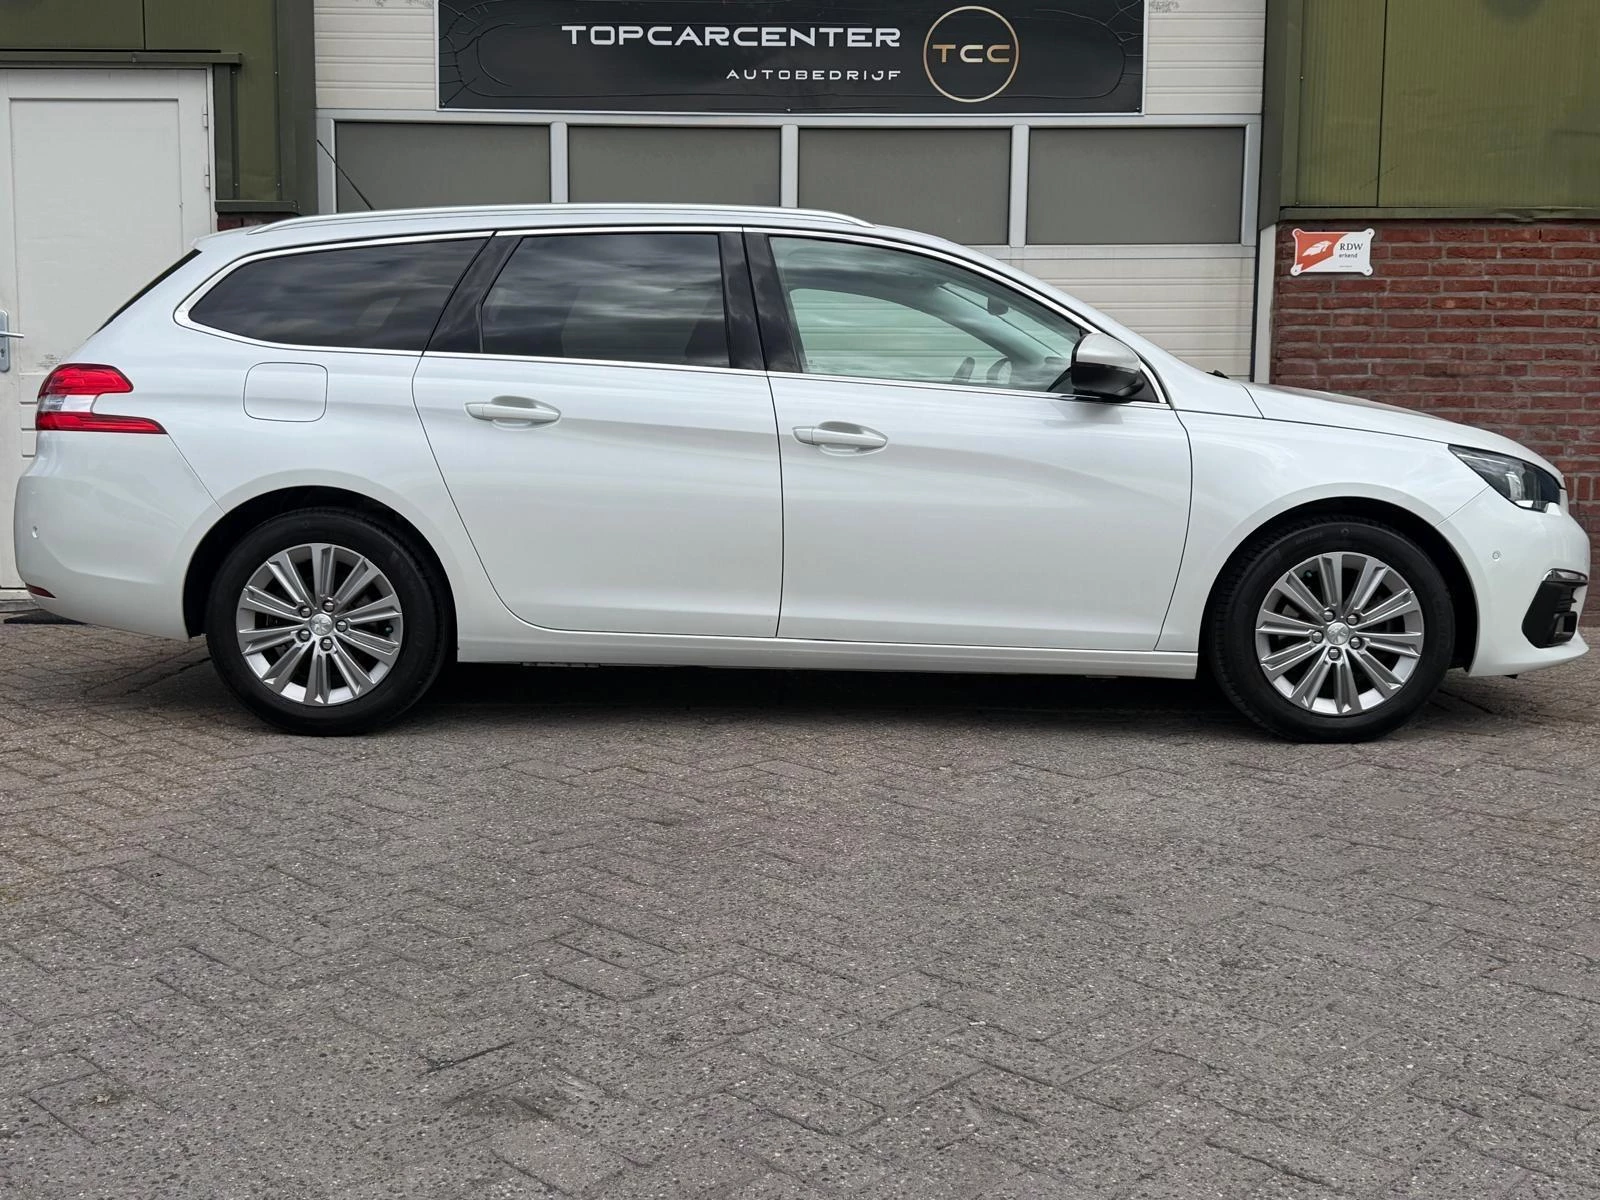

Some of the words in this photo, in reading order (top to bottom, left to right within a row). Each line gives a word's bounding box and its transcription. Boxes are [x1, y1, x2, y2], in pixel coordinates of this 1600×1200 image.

[561, 25, 901, 48] TOPCARCENTER
[932, 44, 1011, 63] TCC
[726, 69, 901, 81] AUTOBEDRIJF
[1339, 242, 1363, 251] RDW
